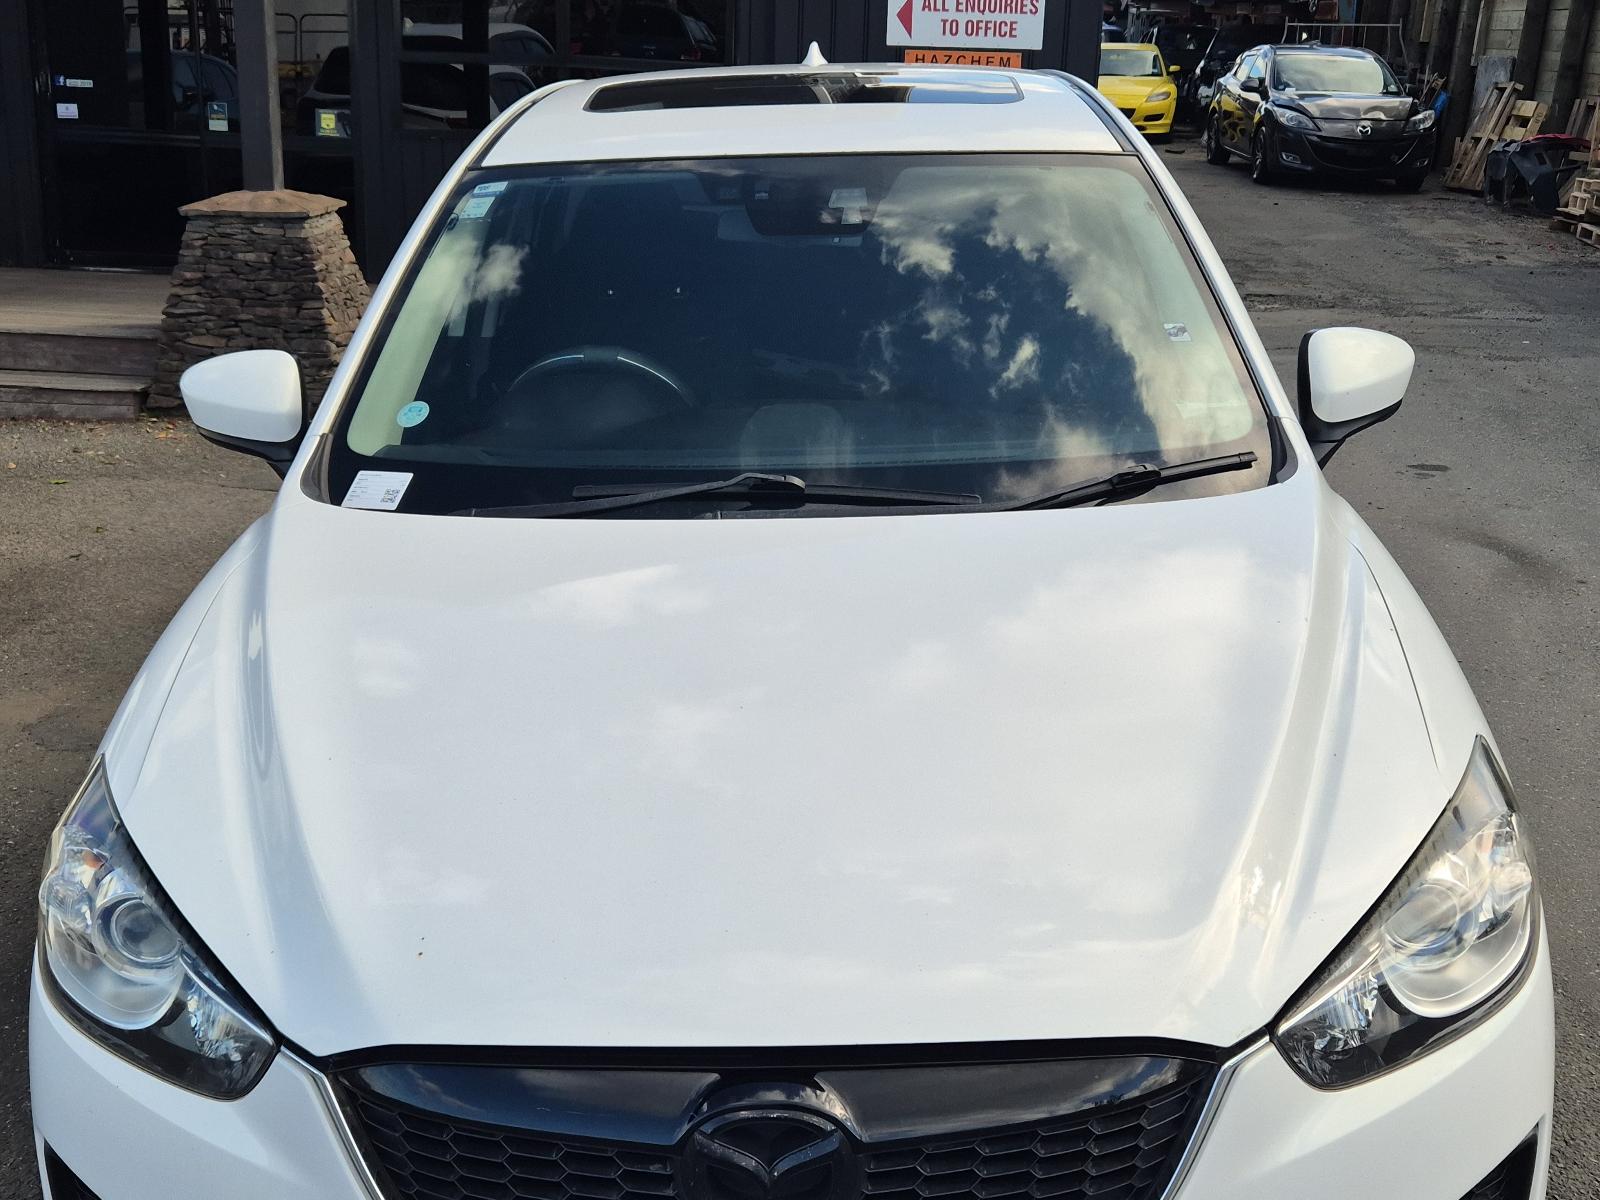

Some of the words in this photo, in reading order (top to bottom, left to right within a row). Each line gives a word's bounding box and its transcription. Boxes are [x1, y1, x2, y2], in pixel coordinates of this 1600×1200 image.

[921, 0, 949, 12] ALL
[955, 0, 1039, 15] ENQUIRIES
[941, 19, 959, 37] TO
[965, 19, 1018, 38] OFFICE
[915, 53, 1011, 68] HAZCHEM
